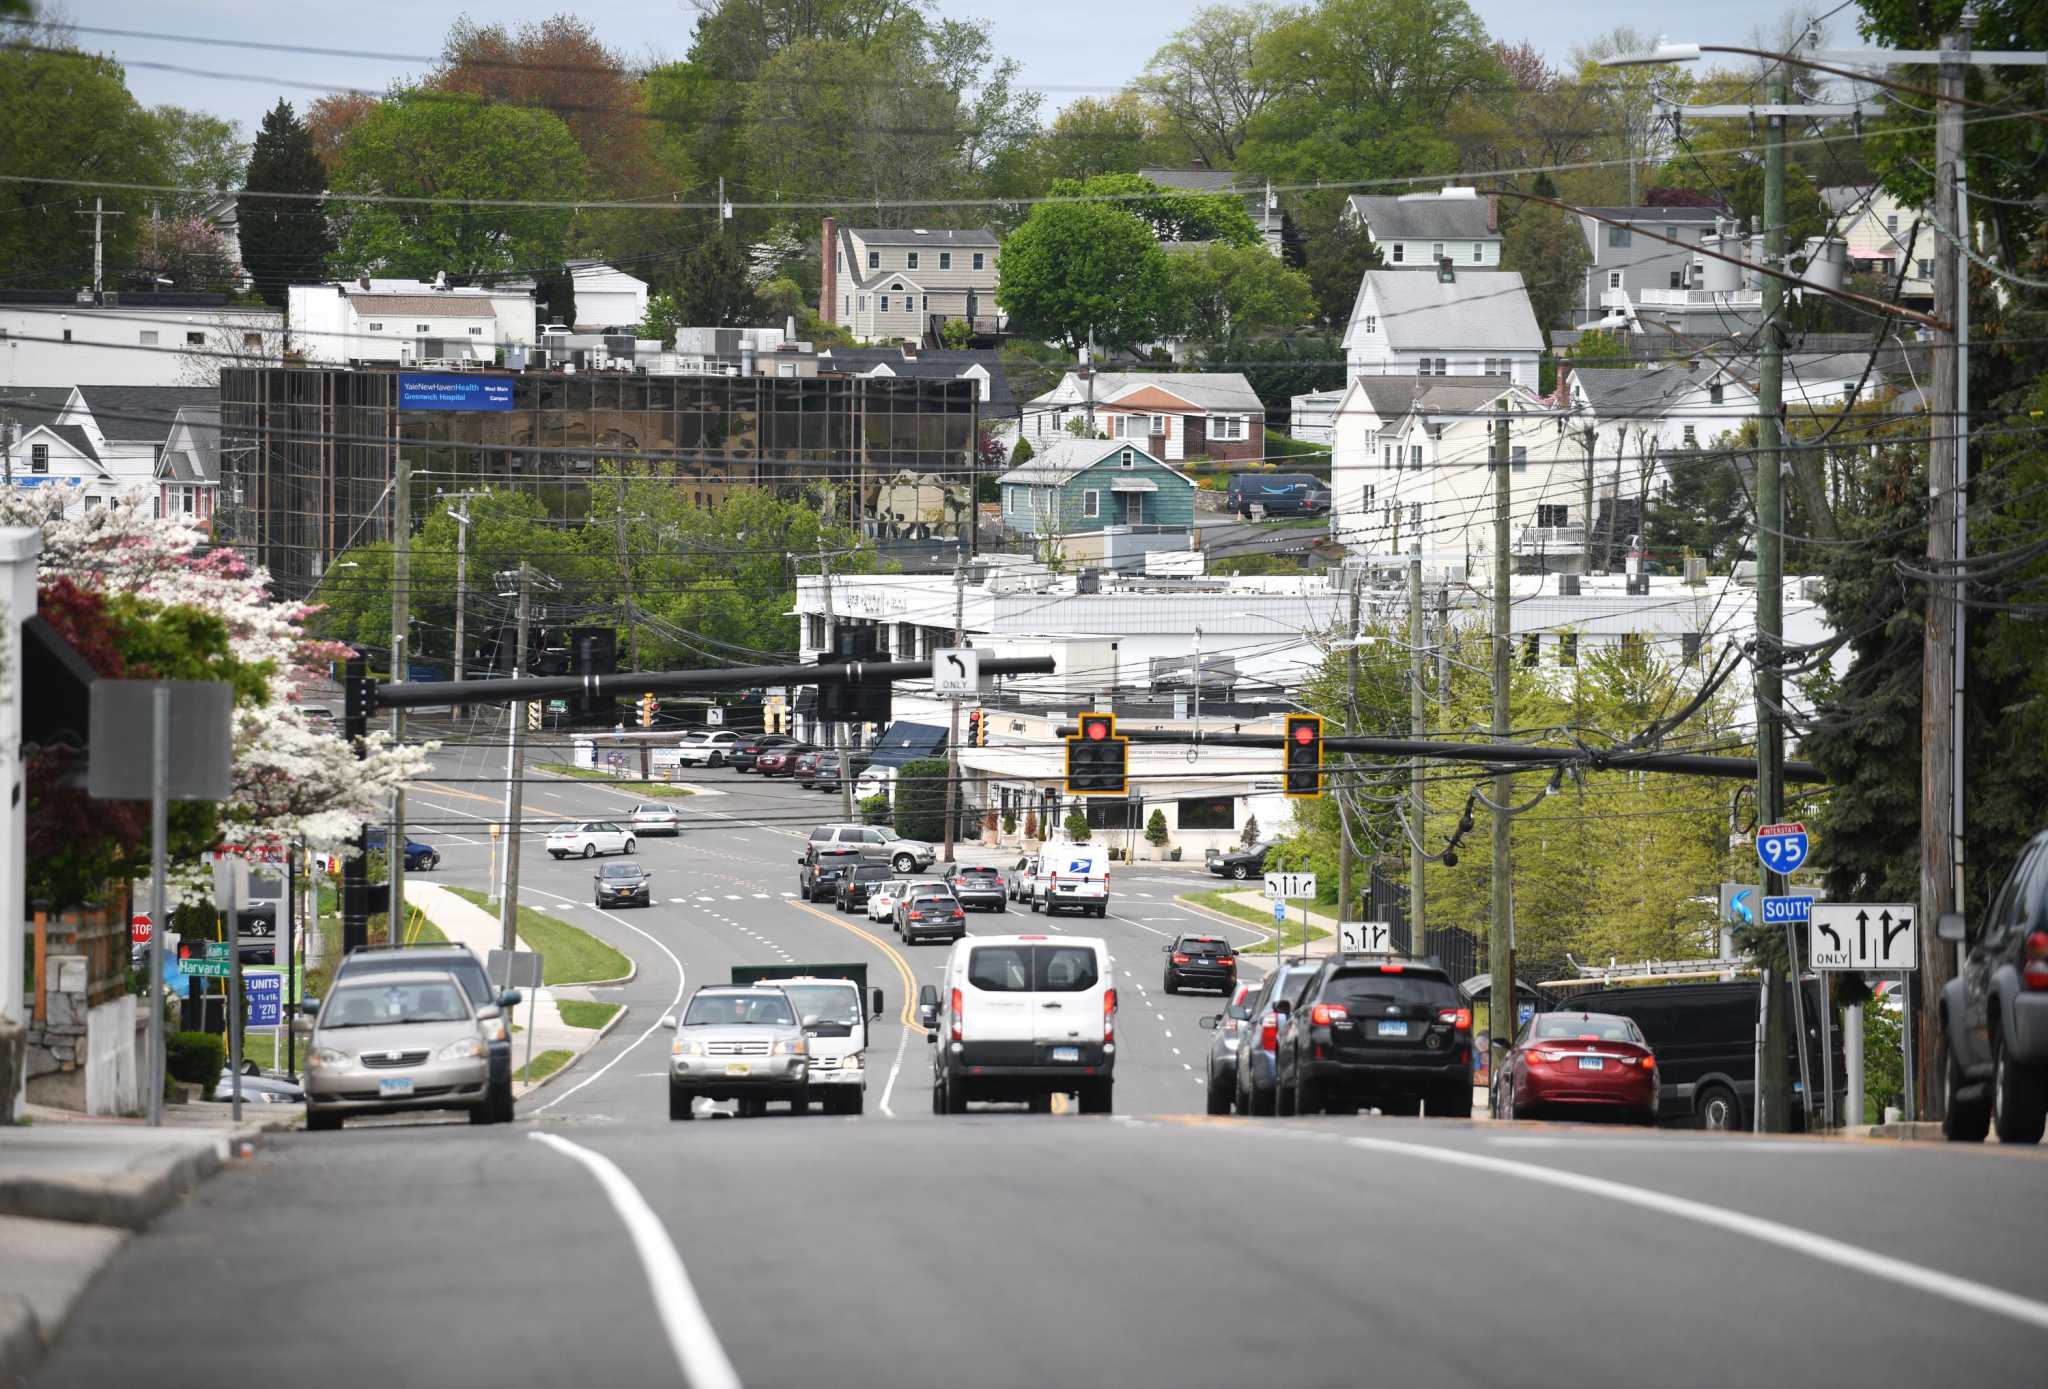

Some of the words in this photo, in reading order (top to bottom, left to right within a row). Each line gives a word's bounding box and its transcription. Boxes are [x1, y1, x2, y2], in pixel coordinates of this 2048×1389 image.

[440, 393, 466, 402] Hospital
[943, 680, 968, 689] ONLY
[1763, 825, 1800, 835] INTERSTATE
[1765, 838, 1801, 862] 95
[1766, 901, 1811, 918] SOUTH
[1817, 953, 1848, 964] ONLY
[180, 961, 221, 975] Harvard
[251, 978, 280, 990] UNITS
